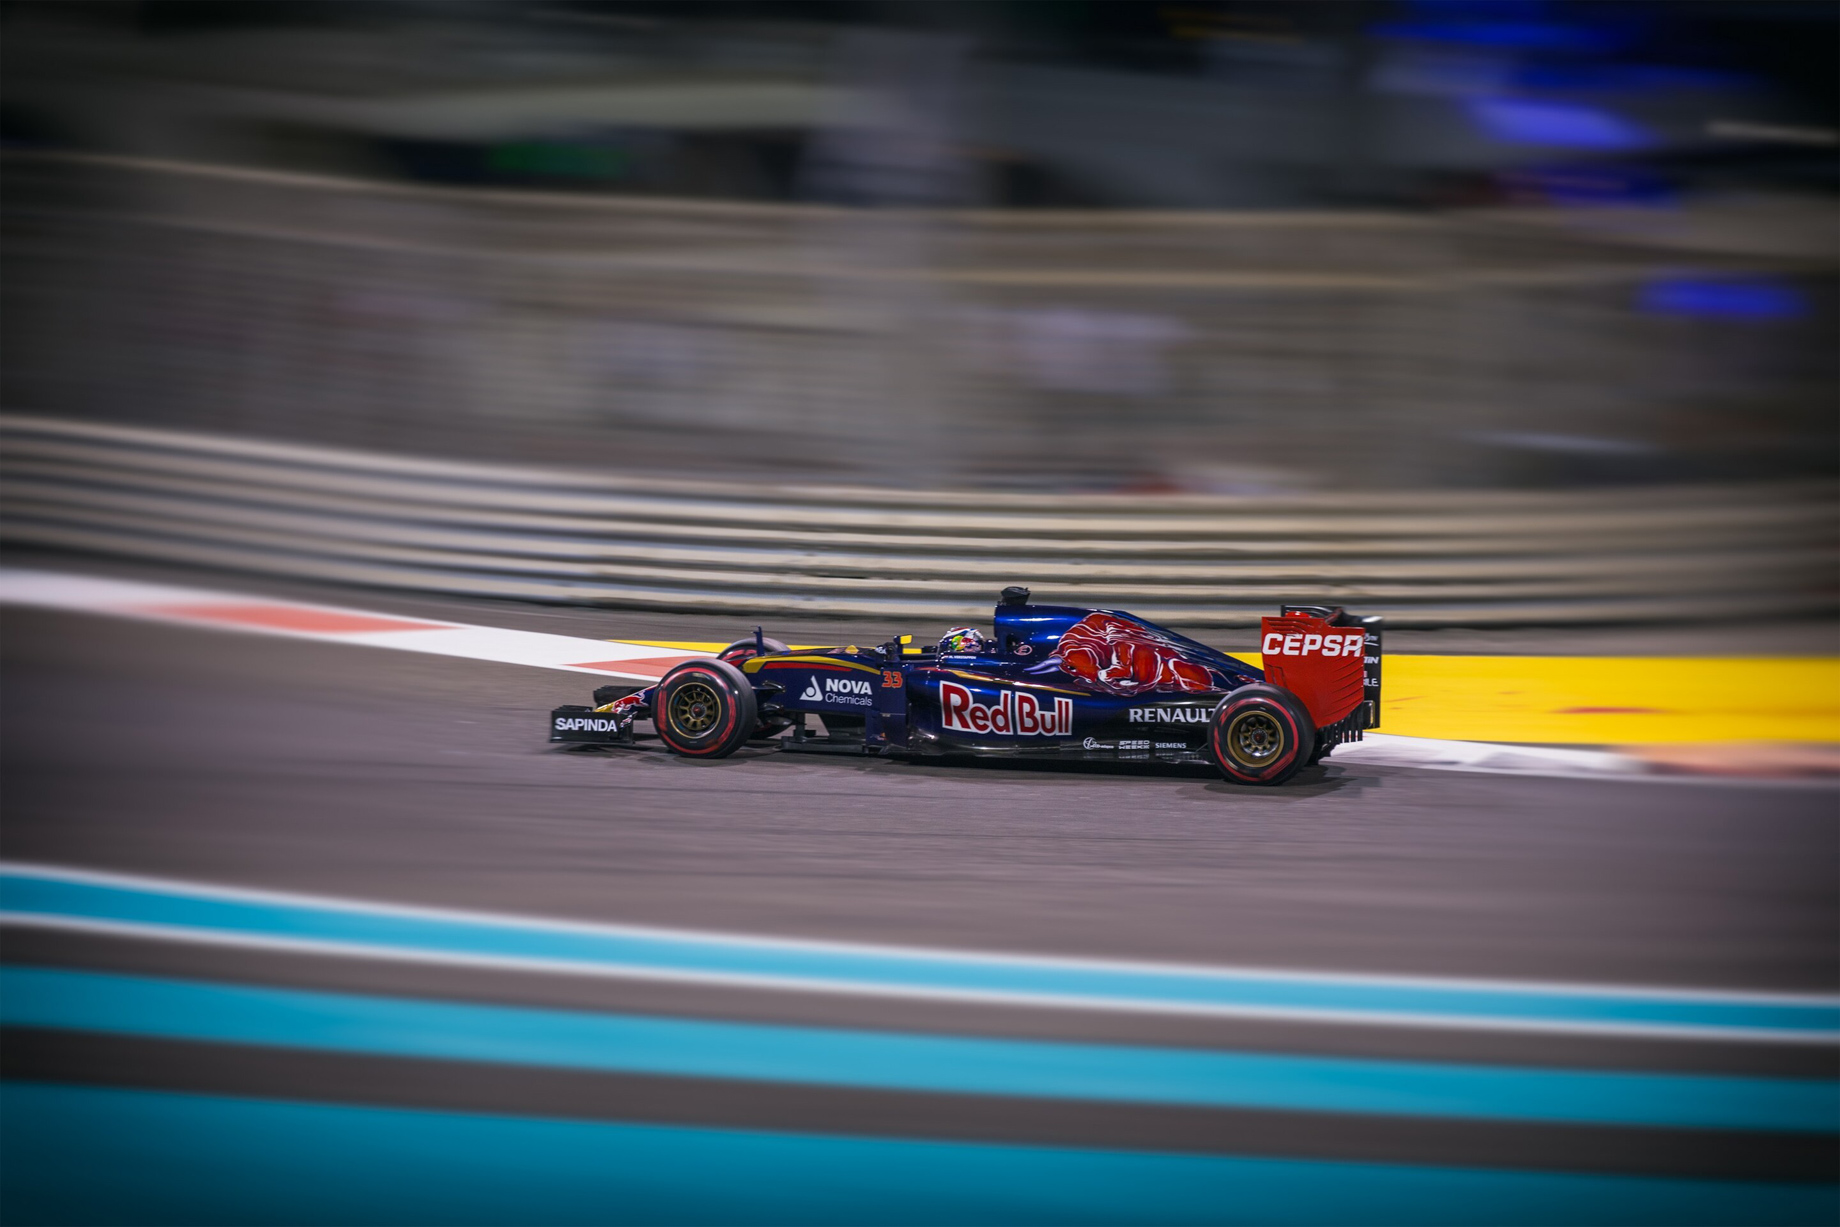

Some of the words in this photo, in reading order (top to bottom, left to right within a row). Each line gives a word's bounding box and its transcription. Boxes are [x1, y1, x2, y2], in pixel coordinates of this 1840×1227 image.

[1262, 633, 1364, 657] CEPSA
[826, 678, 873, 695] NOVA
[881, 671, 903, 688] 33
[825, 692, 873, 706] Chemicals
[940, 680, 1014, 736] Red
[1015, 692, 1073, 737] Bull
[555, 717, 618, 732] SAPINDA
